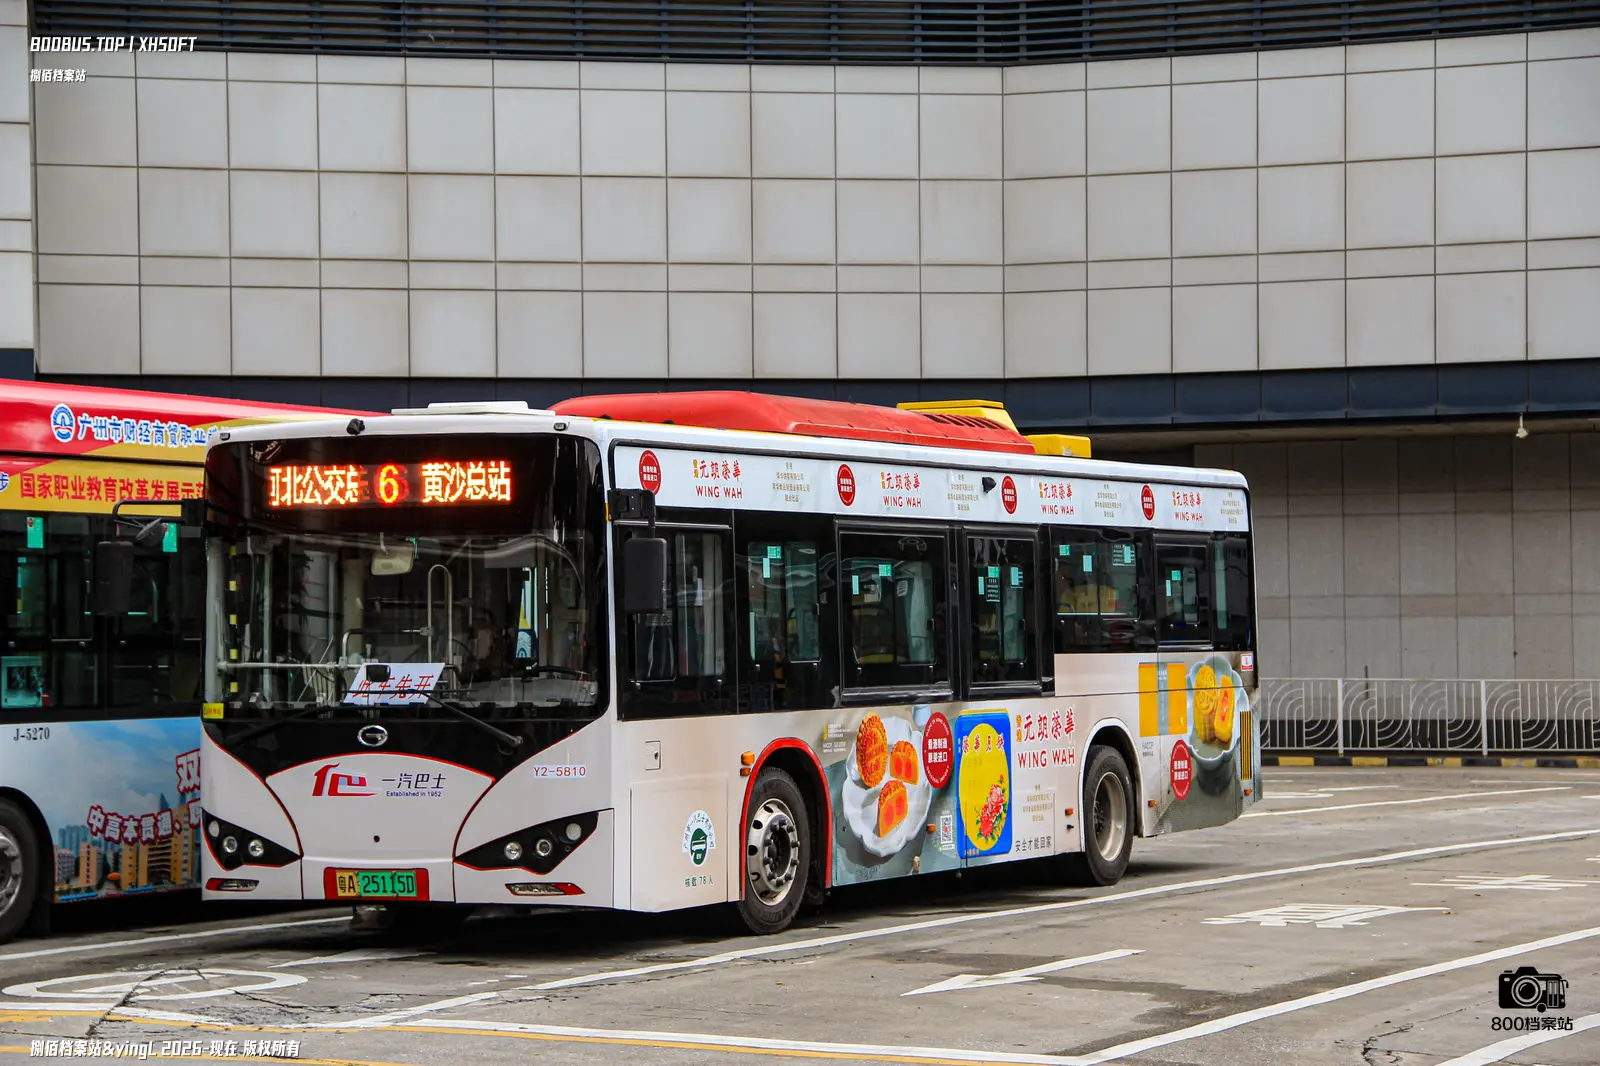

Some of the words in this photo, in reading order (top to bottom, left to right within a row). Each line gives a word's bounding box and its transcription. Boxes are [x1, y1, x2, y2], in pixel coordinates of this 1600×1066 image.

[379, 464, 399, 504] 6
[422, 461, 511, 503] 黄沙总站
[696, 485, 720, 498] WING
[723, 487, 743, 499] WAH
[883, 495, 903, 507] WING
[905, 496, 922, 508] WAH
[1041, 504, 1059, 515] WING
[1060, 505, 1075, 516] WAH
[1174, 511, 1190, 521] WING
[1191, 512, 1204, 521] WAH
[13, 727, 50, 742] J-5270
[1017, 750, 1047, 769] WING
[1051, 747, 1075, 766] WAH
[533, 766, 587, 778] Y2-5810
[382, 773, 446, 789] 一汽巴士
